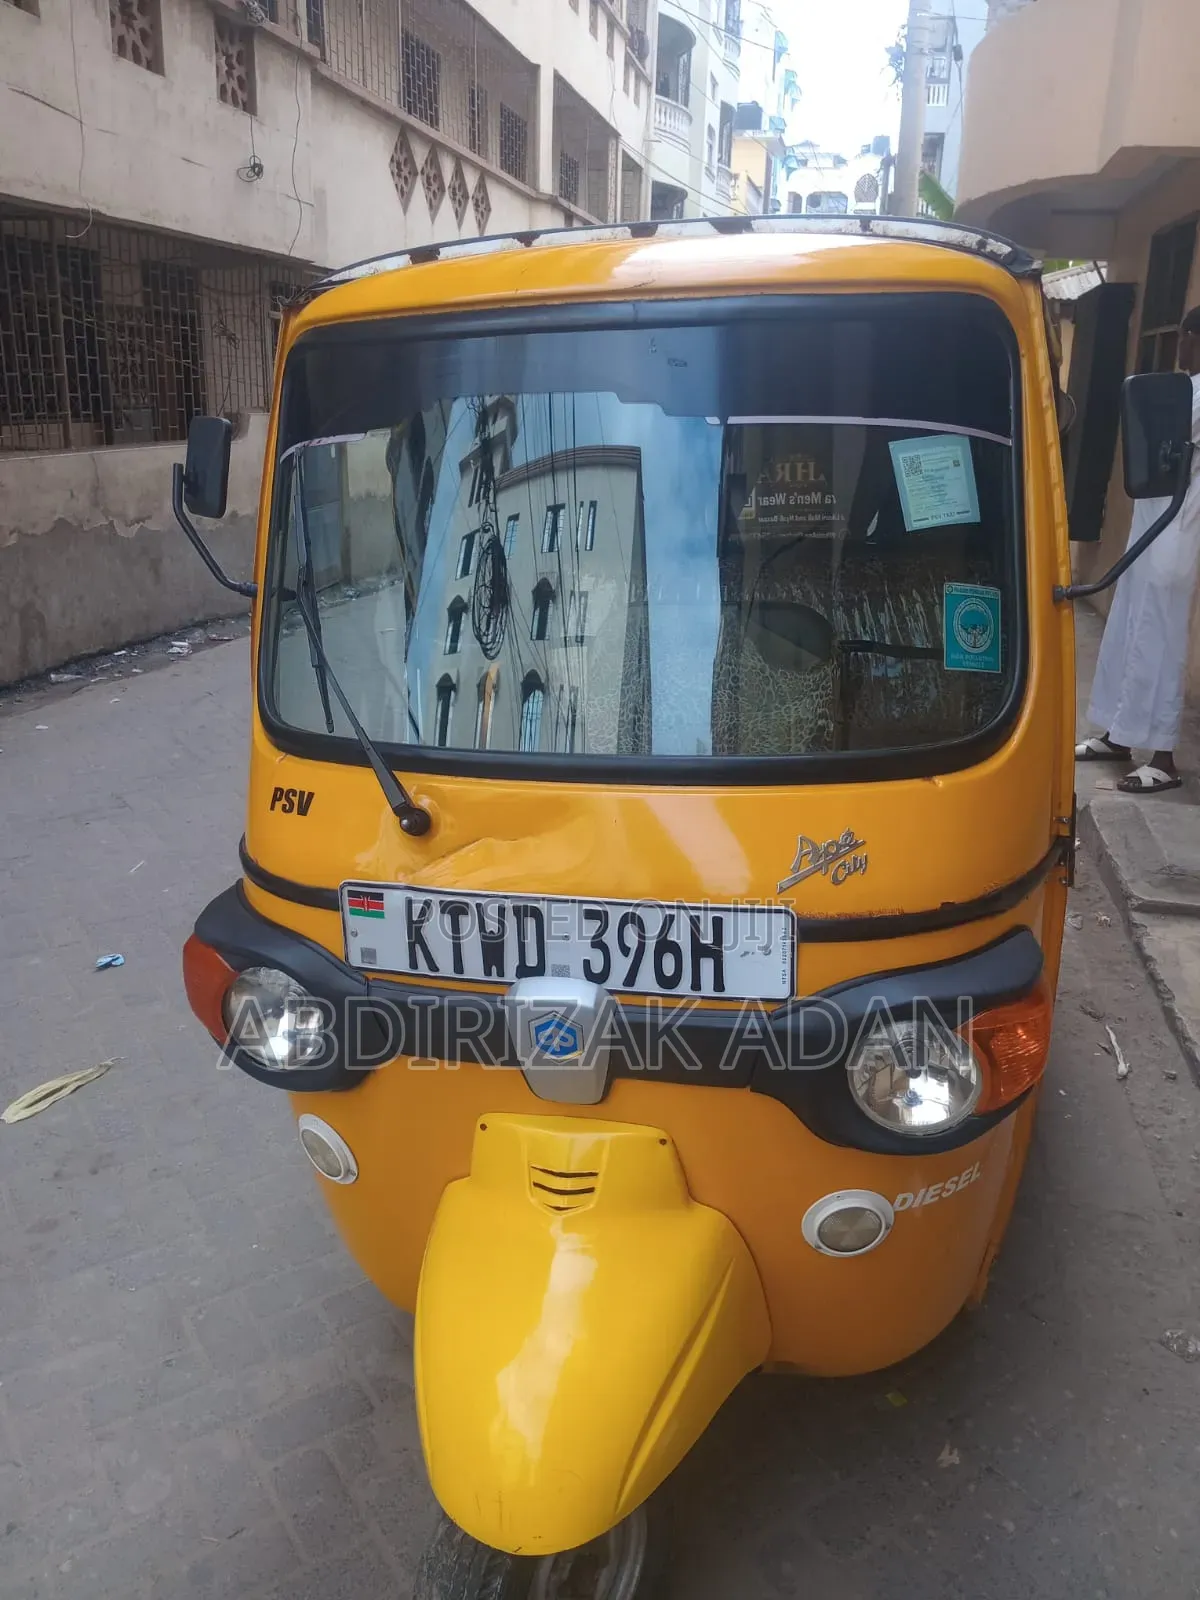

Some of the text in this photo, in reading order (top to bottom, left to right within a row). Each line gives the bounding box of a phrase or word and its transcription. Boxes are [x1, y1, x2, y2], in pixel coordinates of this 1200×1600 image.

[269, 786, 315, 817] PSV
[404, 896, 725, 992] KTWD 396H
[893, 1161, 981, 1212] DIESEL
